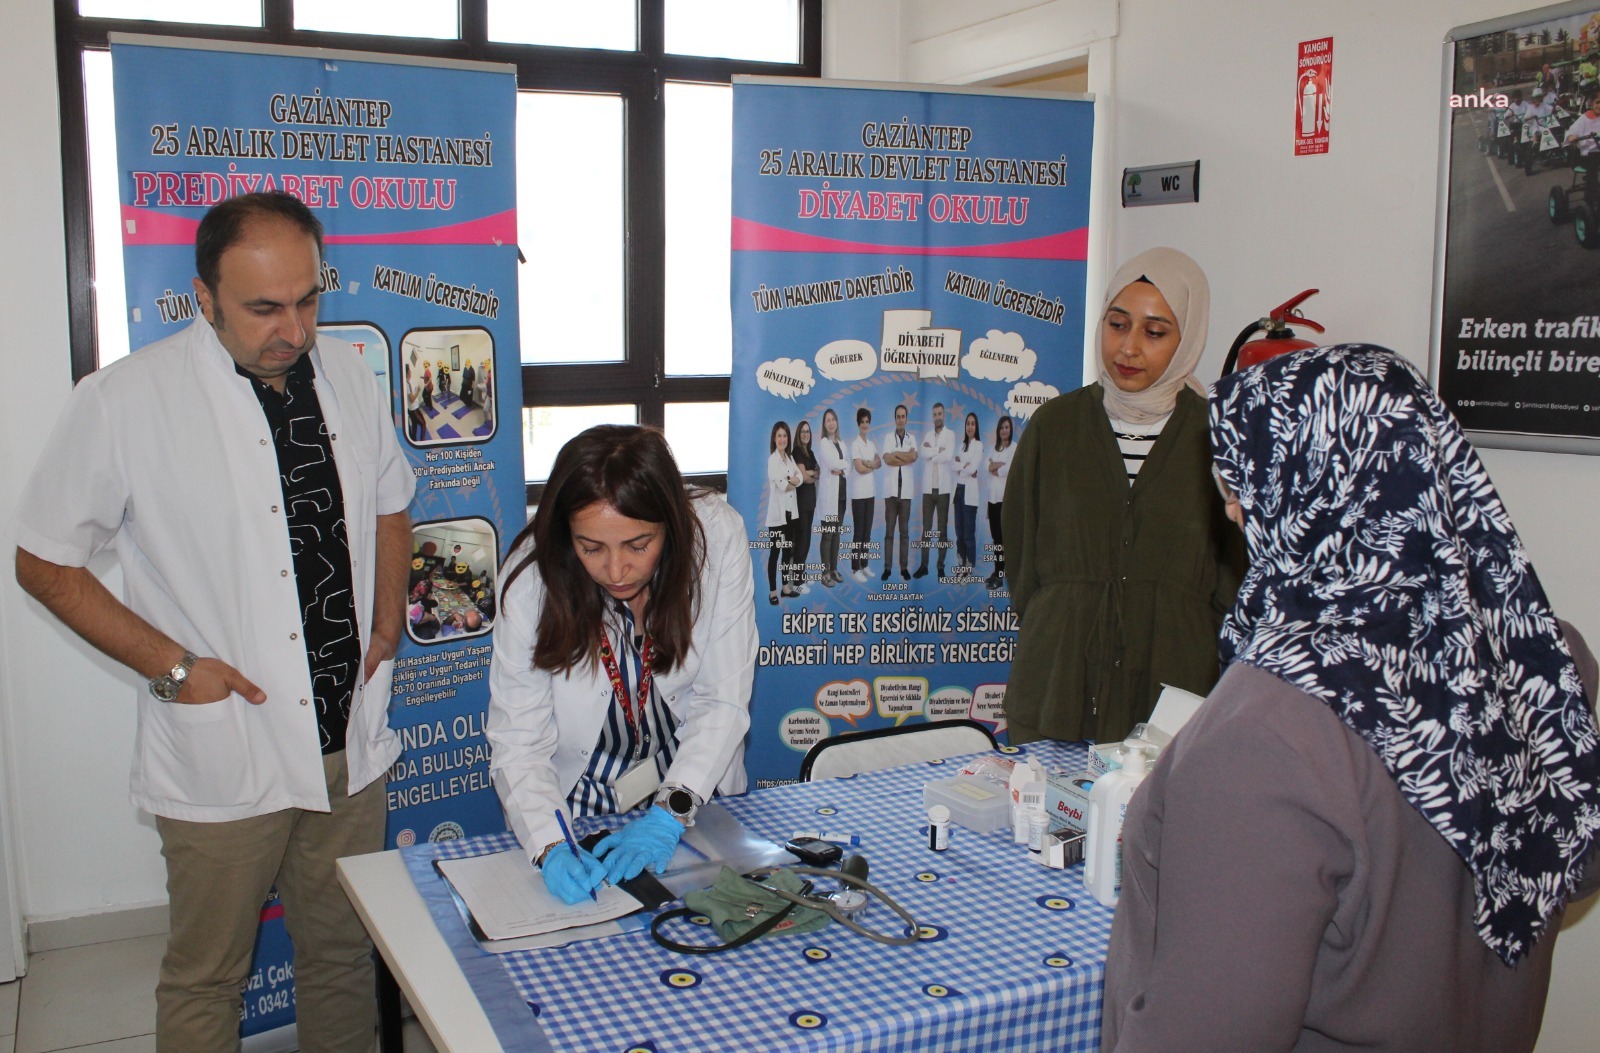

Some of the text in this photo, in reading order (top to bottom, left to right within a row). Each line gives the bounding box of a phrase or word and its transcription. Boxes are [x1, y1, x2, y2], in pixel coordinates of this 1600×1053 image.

[1304, 41, 1329, 54] YANGIN
[1299, 52, 1332, 68] SÖNDÜRÜCÜ
[270, 88, 392, 128] GAZİANTEP
[862, 116, 972, 152] GAZİANTEP
[151, 124, 492, 167] 25 ARALIK DEVLET HASTANESİ
[759, 149, 1067, 187] 25 ARALIK DEVLET HASTANESİ
[350, 176, 457, 211] OKULU
[1161, 175, 1180, 192] WC
[798, 181, 1029, 225] DİYABET OKULU
[373, 264, 500, 320] KATILIM ÜCRETSİZDİR
[752, 265, 914, 314] TÜM HALKIMIZ DAVETLİDİR
[945, 270, 1066, 325] KATILIM ÜCRETSİZDİR
[155, 289, 195, 324] TÜM
[1458, 315, 1600, 339] Erken trafik
[898, 332, 945, 349] DİYABETİ
[829, 351, 864, 366] GÖREREK
[883, 347, 956, 367] ÖĞRENİYORUZ
[979, 348, 1019, 365] EĞLENEREK
[1457, 349, 1600, 378] bilinçli bire
[763, 369, 806, 391] DİNLEYEREK
[1550, 403, 1579, 411] Belediyesi
[425, 448, 482, 462] Her 100 Kişiden
[429, 463, 472, 476] Prediyabetli
[473, 460, 495, 471] Ancak
[430, 475, 481, 490] Farkında Değil
[813, 525, 836, 533] BAHAR
[749, 541, 774, 549] ZEYNEP
[984, 543, 1004, 552] PSİKO
[782, 572, 823, 581] YELİZ ÜLKER
[899, 593, 924, 601] BAYTAK
[782, 606, 1020, 634] EKİPTE TEK EKSİĞİMİZ SİZSİNİZ
[407, 653, 440, 667] Hastalar
[441, 649, 465, 662] Uygun
[466, 645, 492, 657] Yaşam
[758, 636, 1016, 667] DİYABETİ HEP BİRLİKTE YENECEĞİ
[393, 669, 417, 685] şikliği
[419, 669, 428, 677] ve
[429, 665, 453, 677] Uygun
[454, 658, 479, 670] Tedavi
[416, 677, 451, 691] Oranında
[452, 670, 483, 685] Diyabeti
[406, 687, 457, 706] Engelleyebilir
[825, 699, 839, 707] Zaman
[396, 711, 488, 752] INDA OLU
[788, 717, 820, 725] Karbonhidrat
[805, 727, 820, 735] Neden
[385, 742, 492, 784] NDA BULUŞAL
[387, 765, 495, 811] ENGELLEYELİ
[1057, 801, 1083, 821] Beybi
[239, 961, 295, 992] evzi Çak
[258, 989, 289, 1015] 0342
